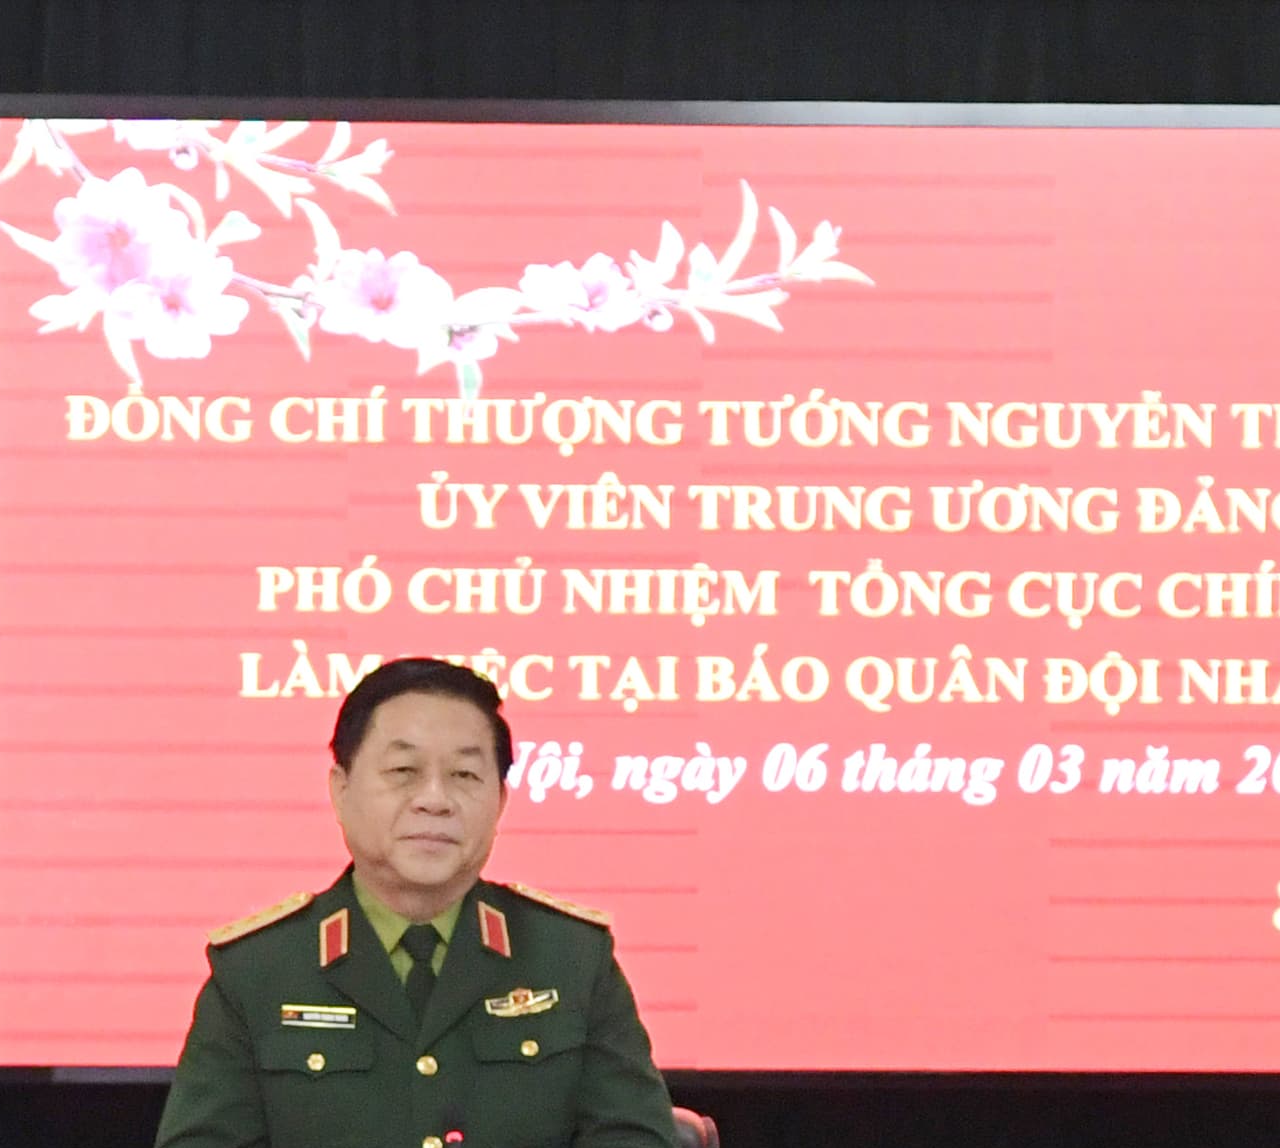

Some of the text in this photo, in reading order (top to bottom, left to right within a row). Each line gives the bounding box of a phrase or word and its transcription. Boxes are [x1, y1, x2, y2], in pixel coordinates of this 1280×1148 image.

[270, 385, 388, 443] CHÍ
[402, 391, 683, 457] THƯỢNG
[698, 387, 931, 448] TƯỚNG
[948, 390, 1216, 450] NGUYỄN
[417, 470, 509, 530] ỦY
[518, 471, 675, 530] VIÊN
[688, 484, 913, 532] TRUNG
[929, 479, 1120, 534] ƯƠNG
[257, 555, 392, 613] PHÓ
[408, 556, 547, 614] CHỦ
[562, 562, 780, 627] NHIỆM
[1007, 571, 1143, 630] CỤC
[568, 655, 680, 712] TẠI
[696, 643, 830, 703] BÁO
[845, 643, 1029, 712] QUÂN
[1044, 650, 1163, 716] ĐỘI
[611, 742, 747, 804] ngày
[762, 743, 829, 792] 06
[841, 743, 1004, 805] tháng
[1017, 744, 1085, 794] 03
[1098, 746, 1221, 794] năm
